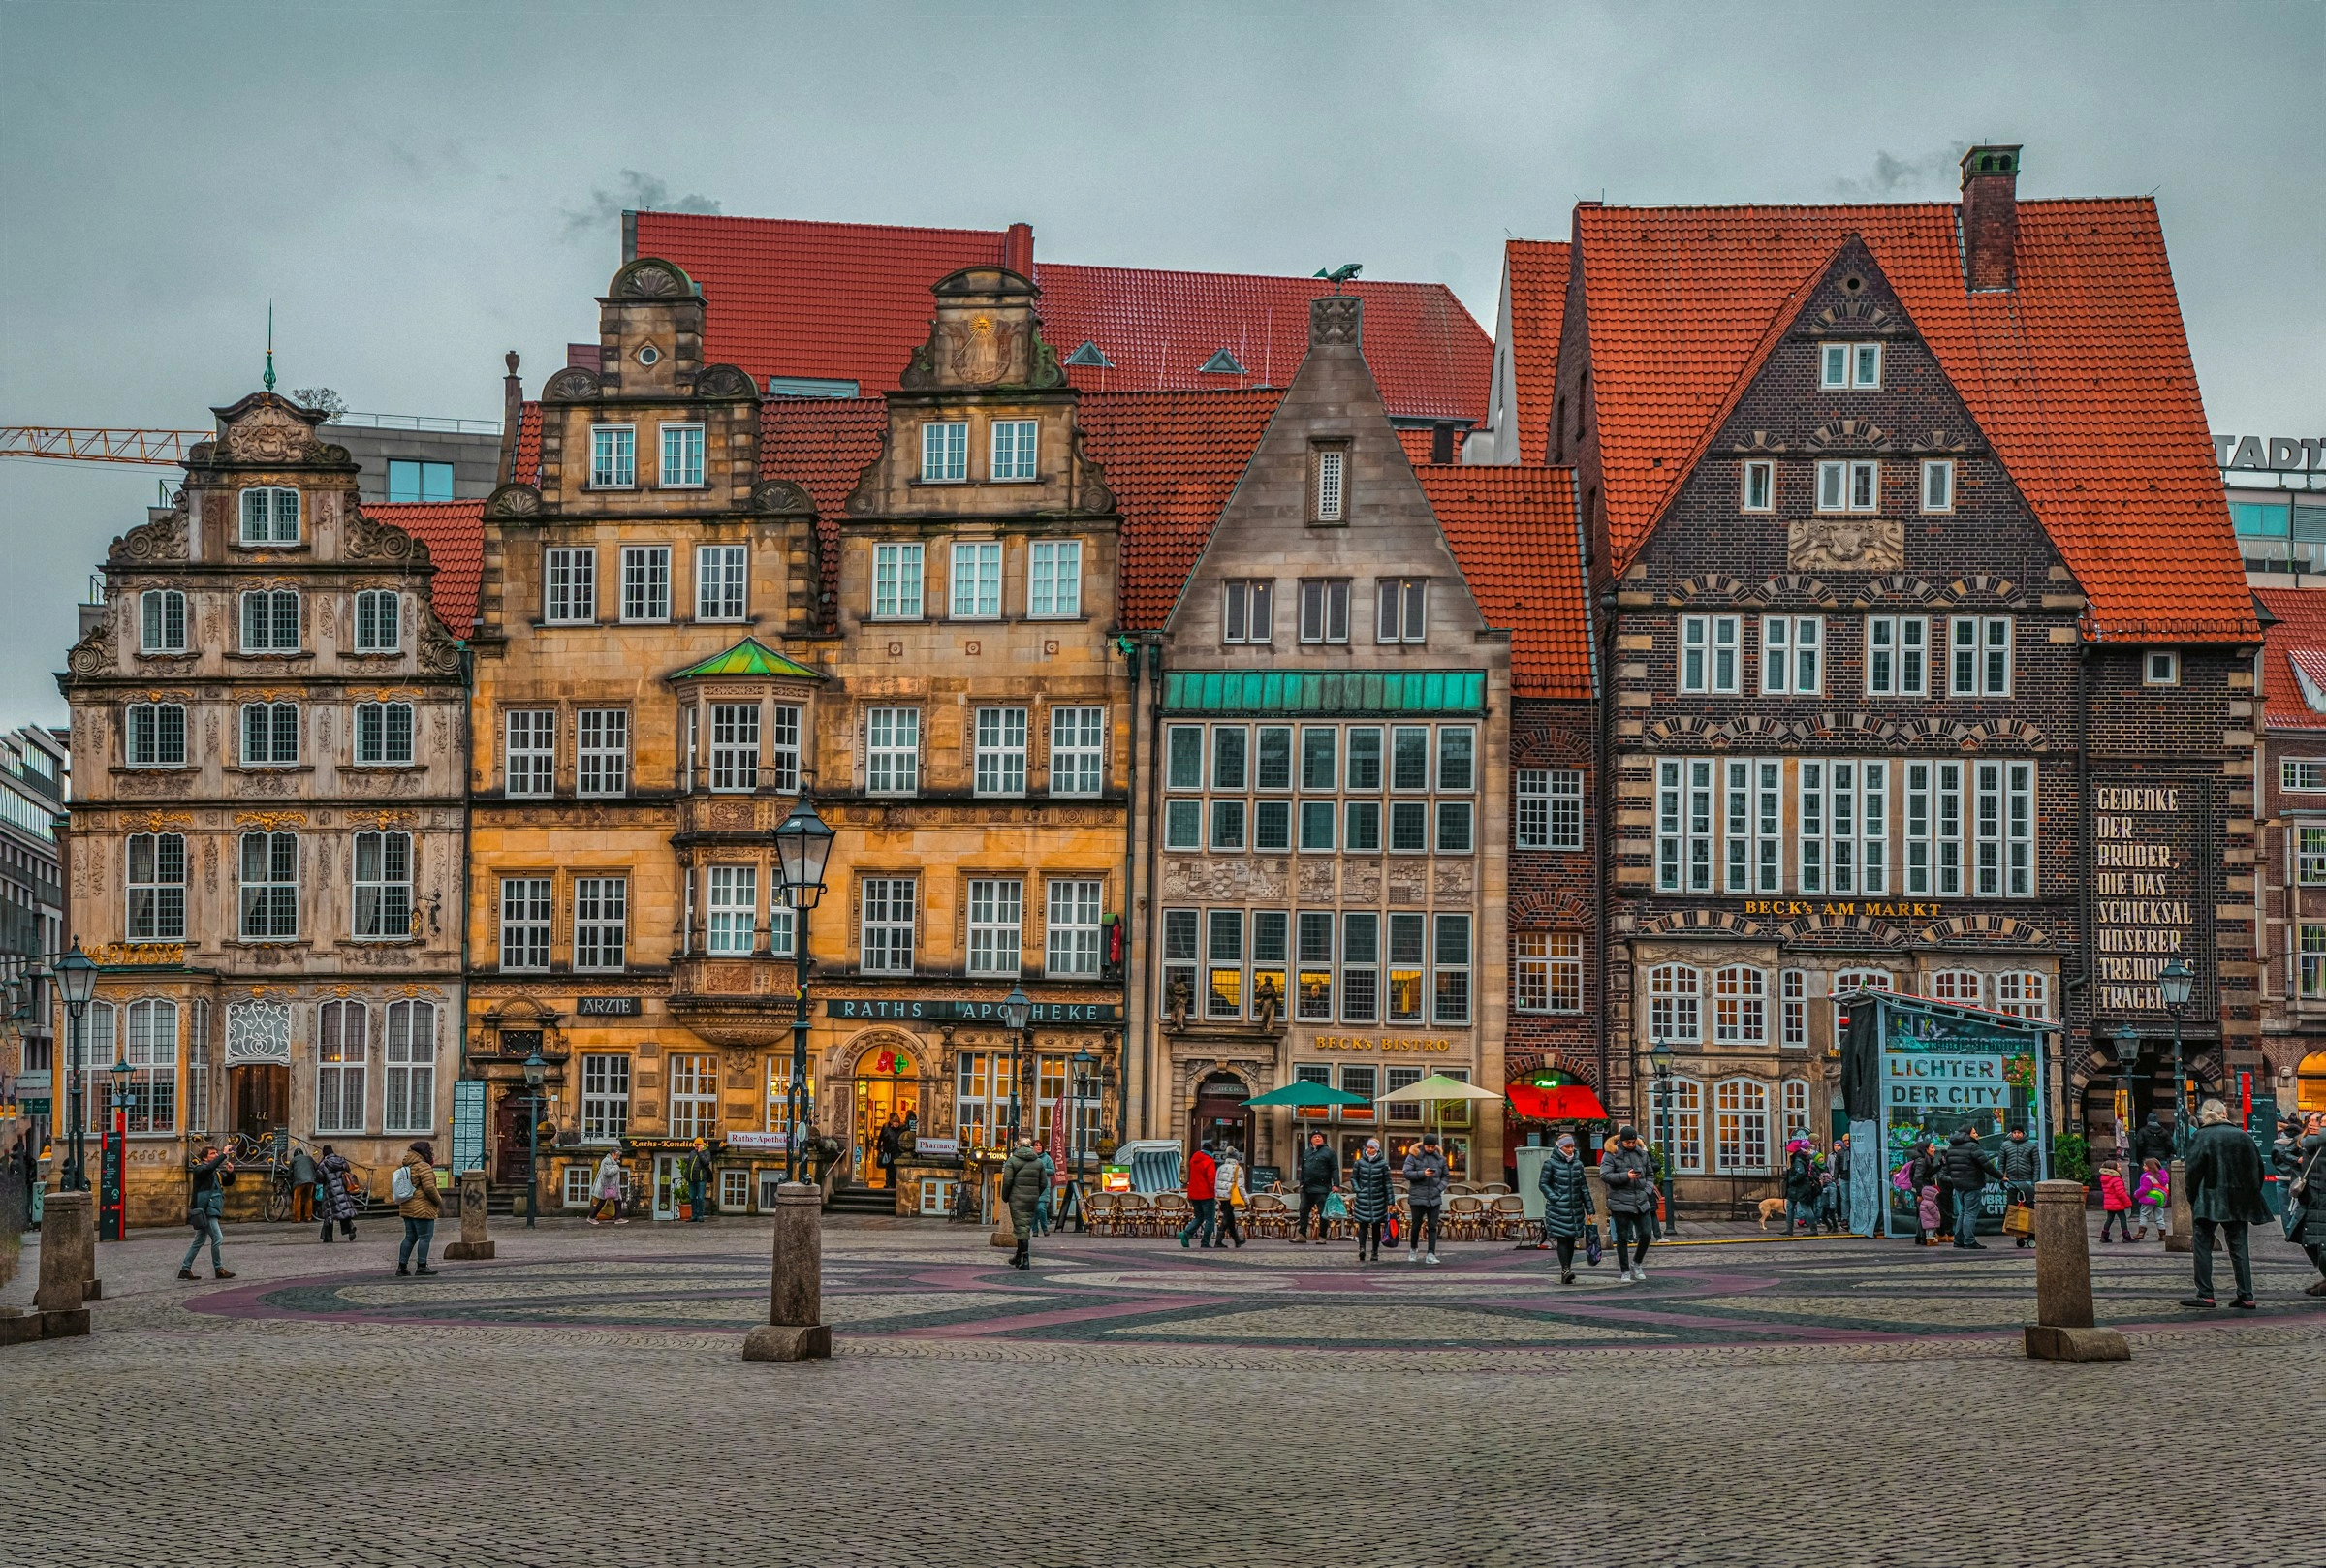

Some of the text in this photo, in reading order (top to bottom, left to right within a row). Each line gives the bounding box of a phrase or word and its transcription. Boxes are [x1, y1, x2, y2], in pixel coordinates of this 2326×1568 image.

[2097, 788, 2179, 811] GEDENKE
[2097, 816, 2133, 839] DER
[2097, 840, 2180, 869] BRÜDER,
[2098, 872, 2166, 895] DIE DAS
[1823, 902, 1855, 916] AM
[1865, 902, 1942, 917] MARKT
[2098, 901, 2193, 925] SCHICKSAL
[2098, 928, 2182, 953] UNSERER
[583, 998, 631, 1013] ÄRZTE
[843, 1001, 1097, 1019] RATHS APOHEKE
[1381, 1038, 1449, 1051] BISTRO
[1891, 1059, 1994, 1078] LICHTER
[1892, 1085, 2002, 1105] DER CITY
[732, 1134, 788, 1145] Raths-Apothek
[920, 1141, 956, 1151] Pharmacy
